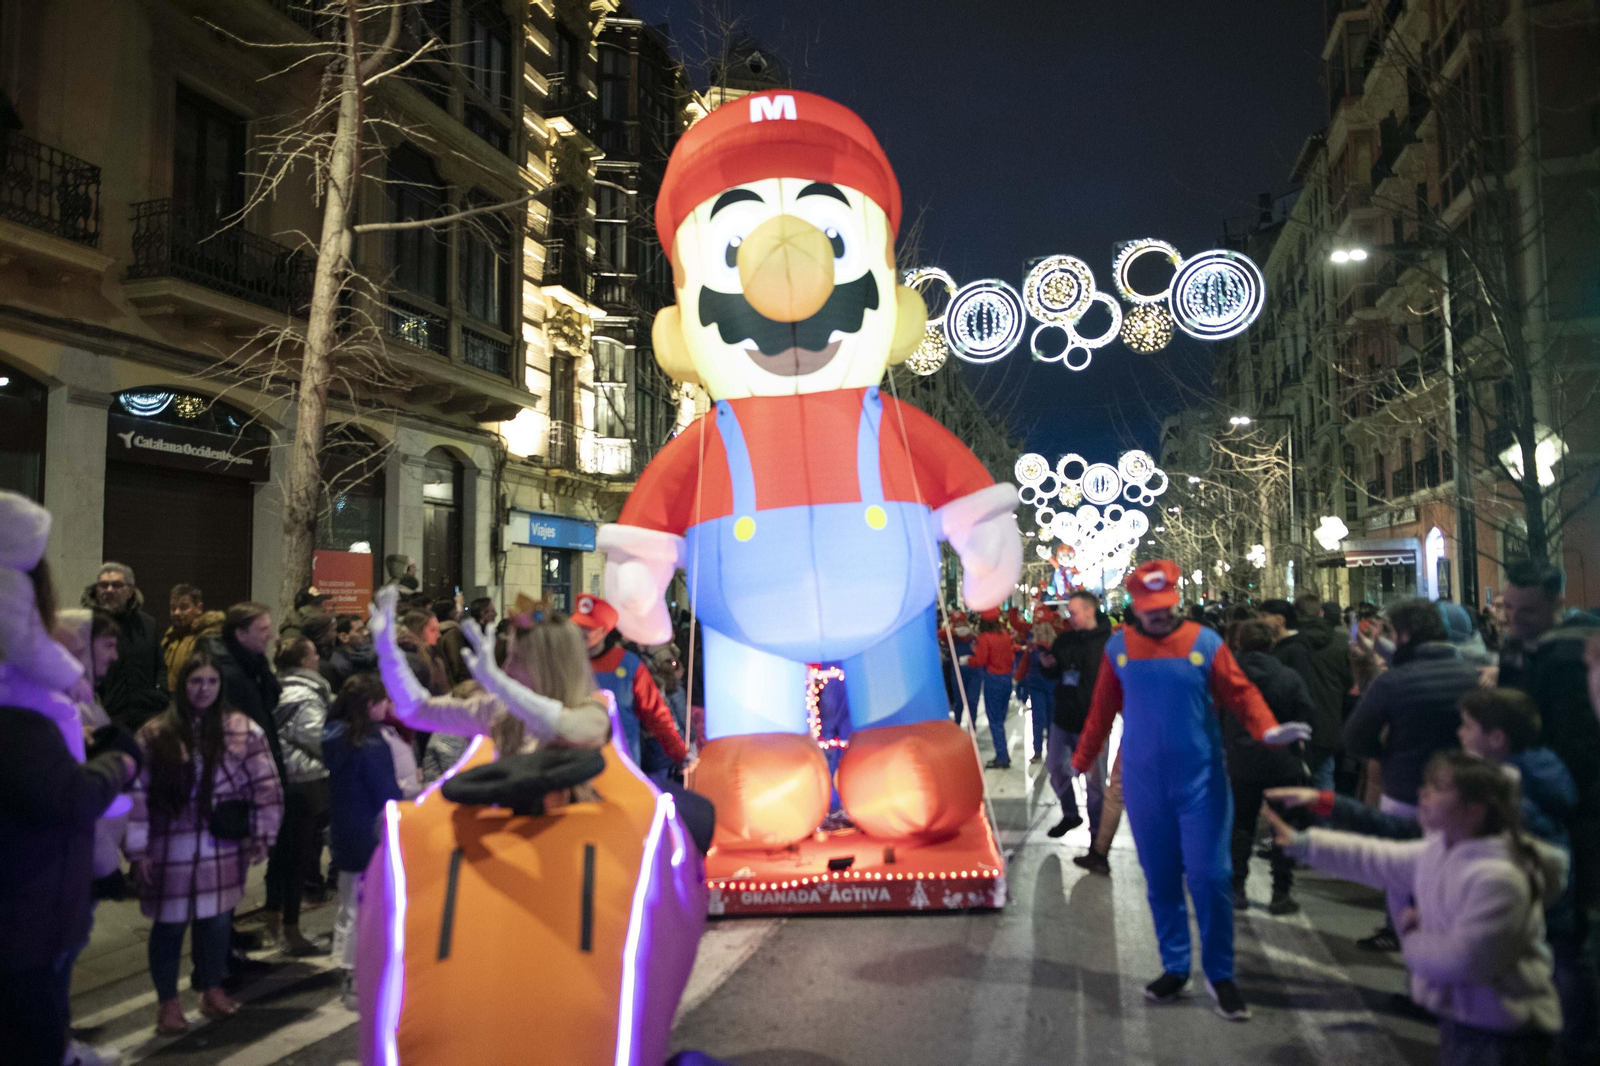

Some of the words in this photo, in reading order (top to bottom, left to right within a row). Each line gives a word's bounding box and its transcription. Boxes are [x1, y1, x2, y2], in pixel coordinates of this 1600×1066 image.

[749, 94, 797, 124] M
[133, 435, 184, 454] Catalana
[183, 443, 232, 461] Occidente
[531, 522, 556, 541] Viajes
[741, 889, 821, 905] GRANADA
[829, 886, 892, 903] ACTIVA
